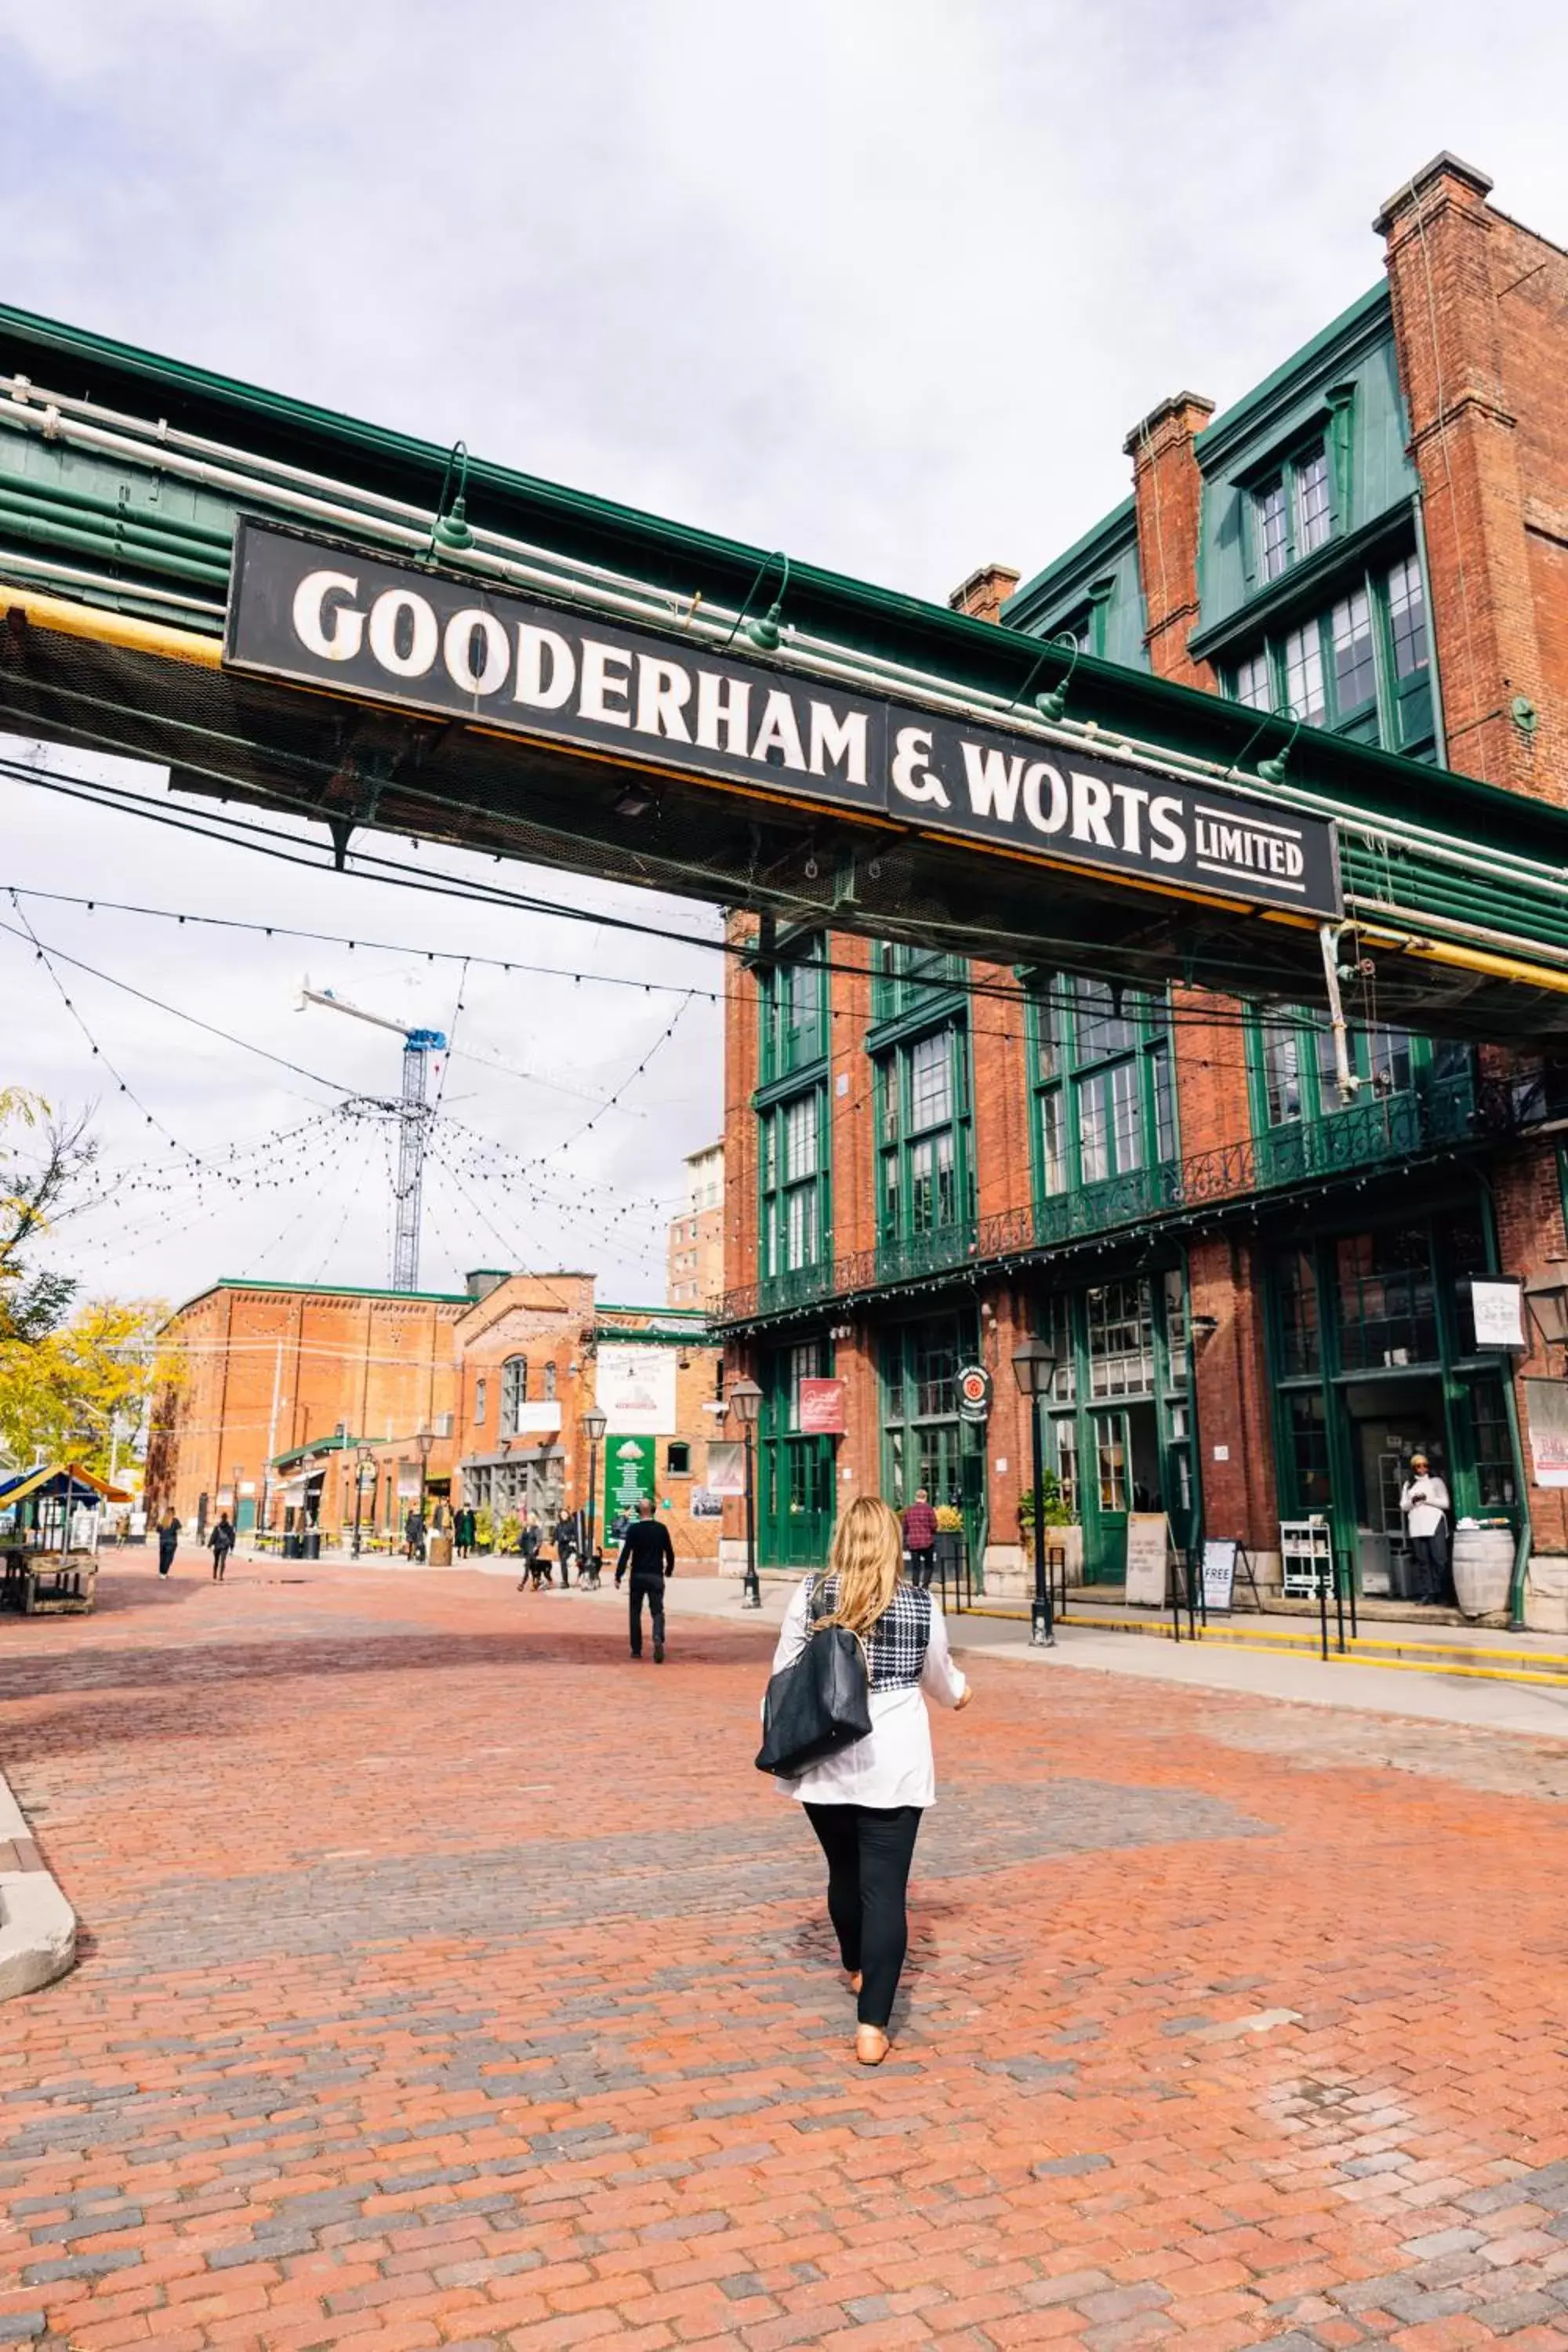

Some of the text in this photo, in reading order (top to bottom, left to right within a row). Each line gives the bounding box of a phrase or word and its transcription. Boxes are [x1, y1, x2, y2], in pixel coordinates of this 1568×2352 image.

[292, 570, 1304, 877] GOODERHAM & WORTS LIMITED
[1204, 1567, 1230, 1580] FREE
